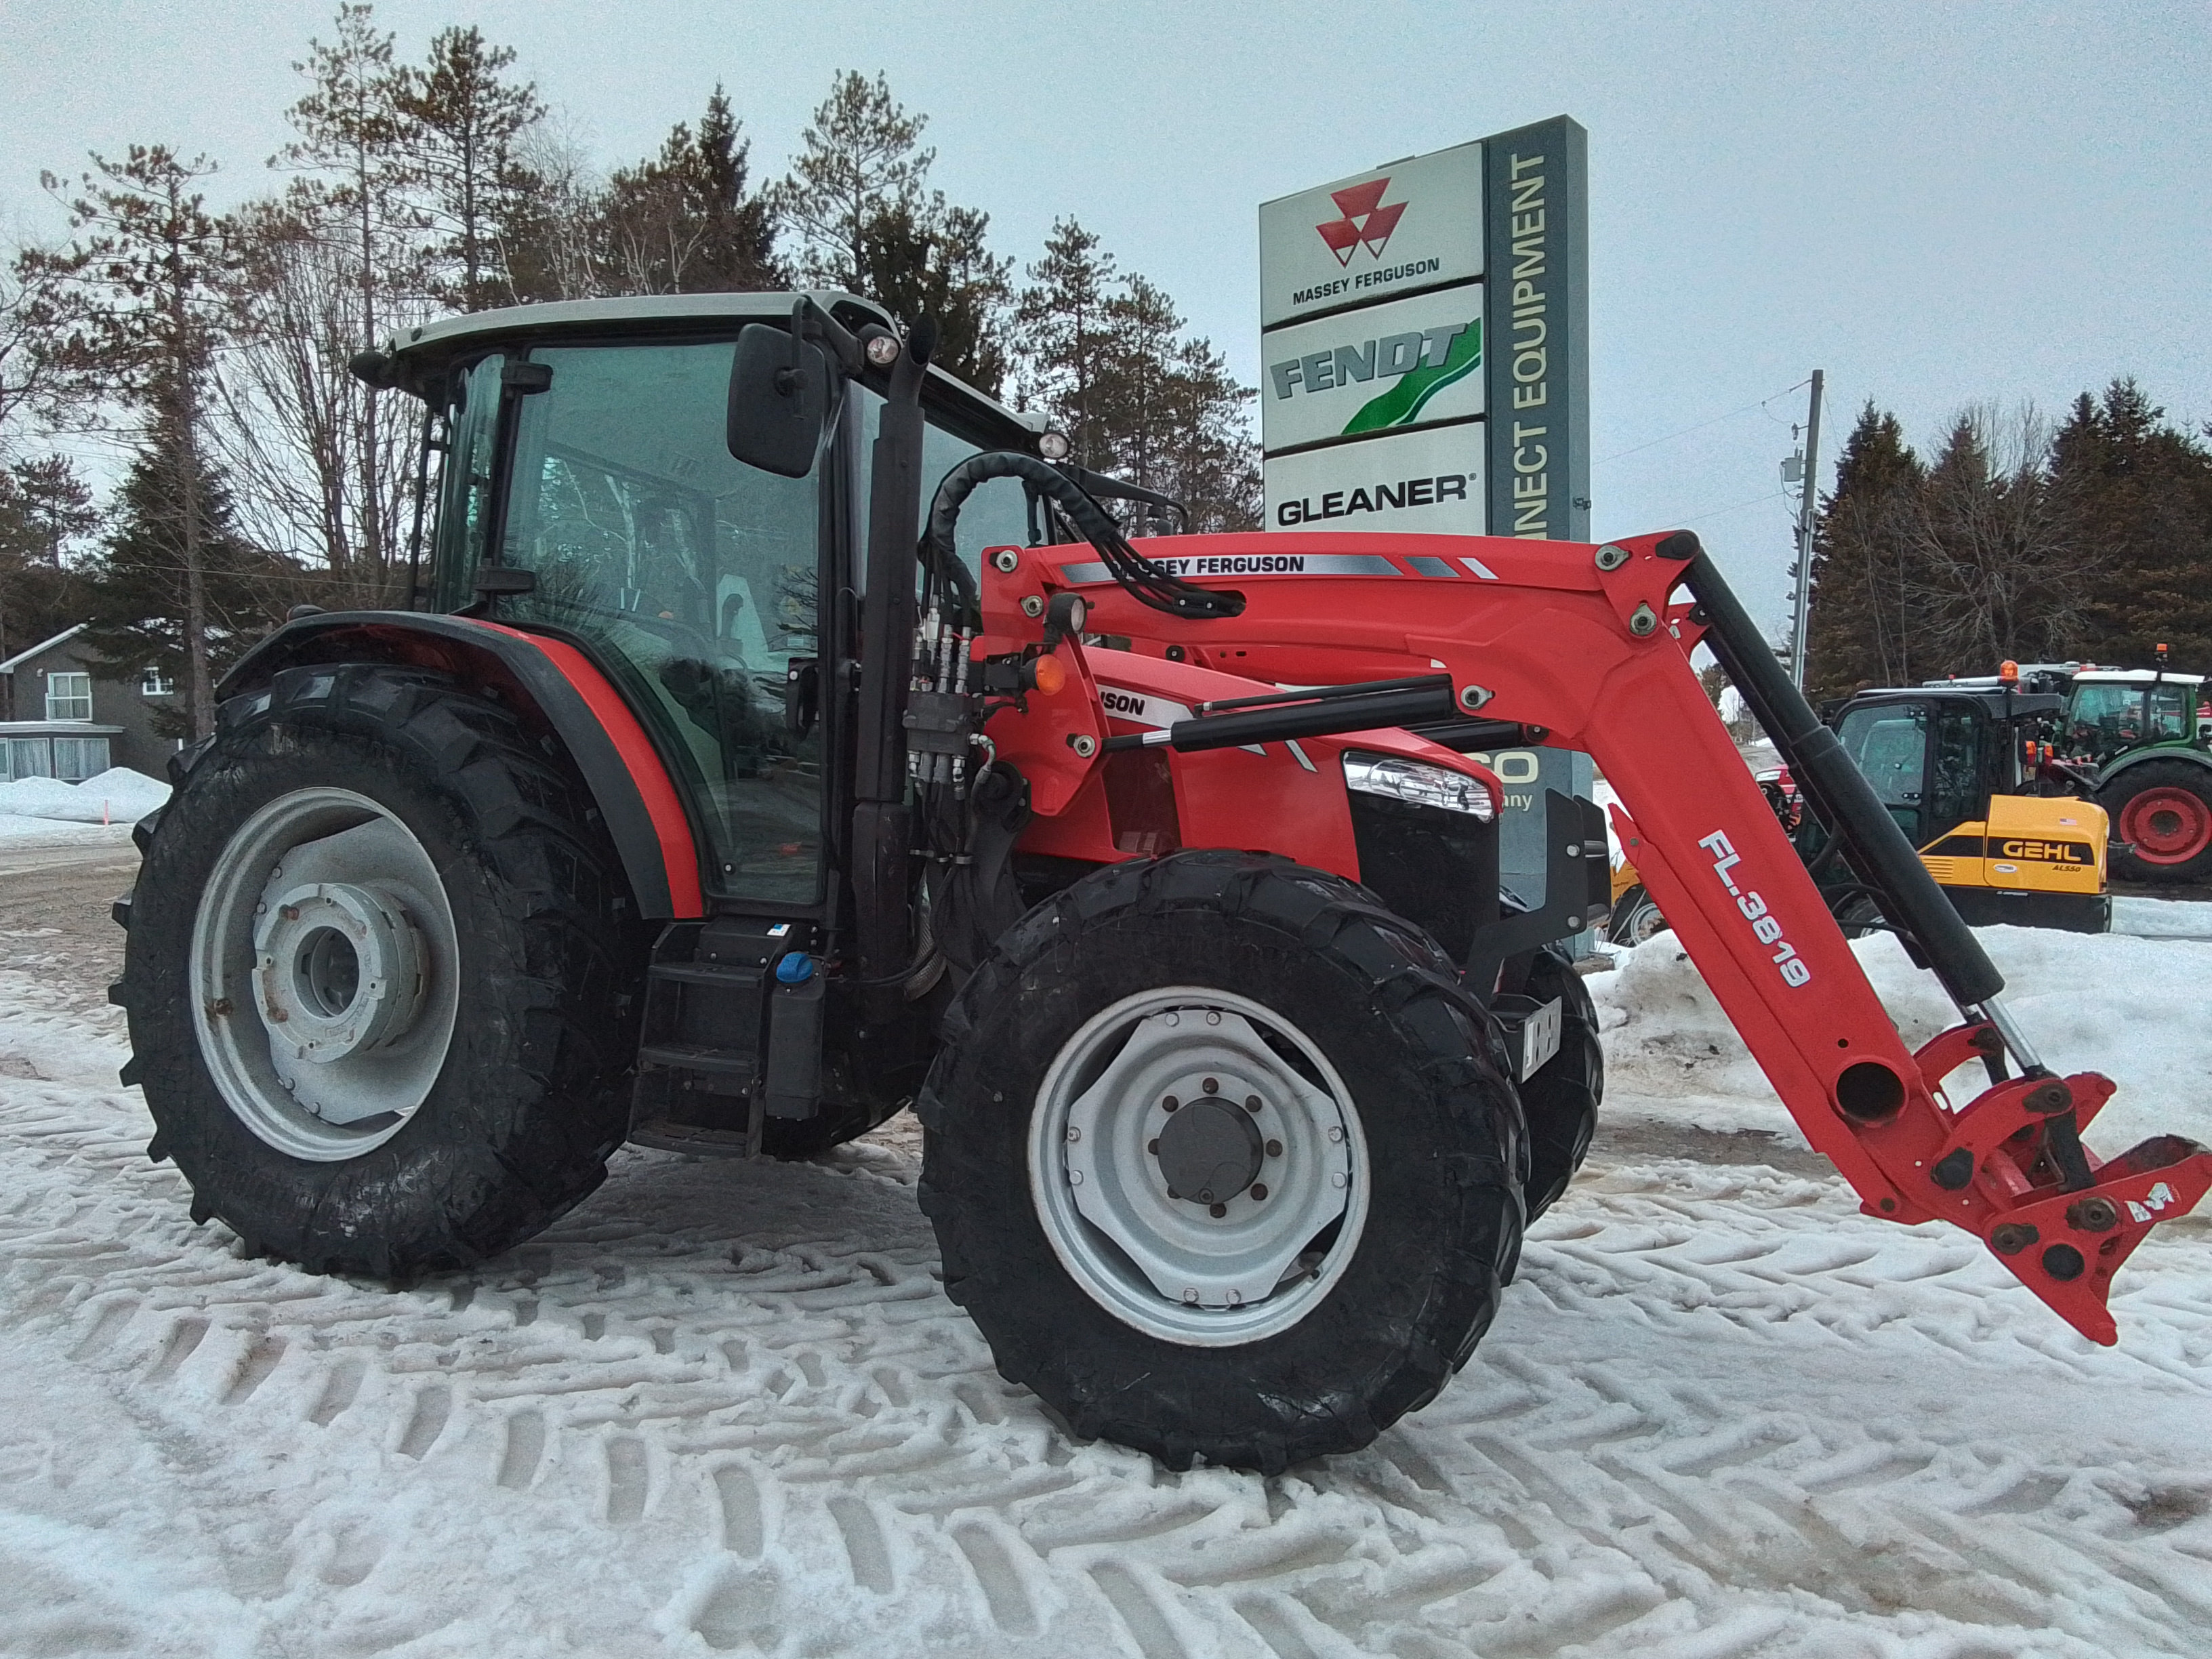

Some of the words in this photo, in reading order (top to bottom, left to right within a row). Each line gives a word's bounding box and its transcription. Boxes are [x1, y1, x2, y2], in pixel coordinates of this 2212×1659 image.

[1292, 277, 1350, 305] MASSEY
[1355, 257, 1439, 289] FERGUSON
[1511, 153, 1548, 409] EQUIPMENT
[1270, 323, 1469, 400] FENDT
[1514, 422, 1548, 540] NECT
[1196, 556, 1305, 574] FERGUSON
[2003, 840, 2082, 861] GEHL
[1698, 829, 1811, 988] FL.3819
